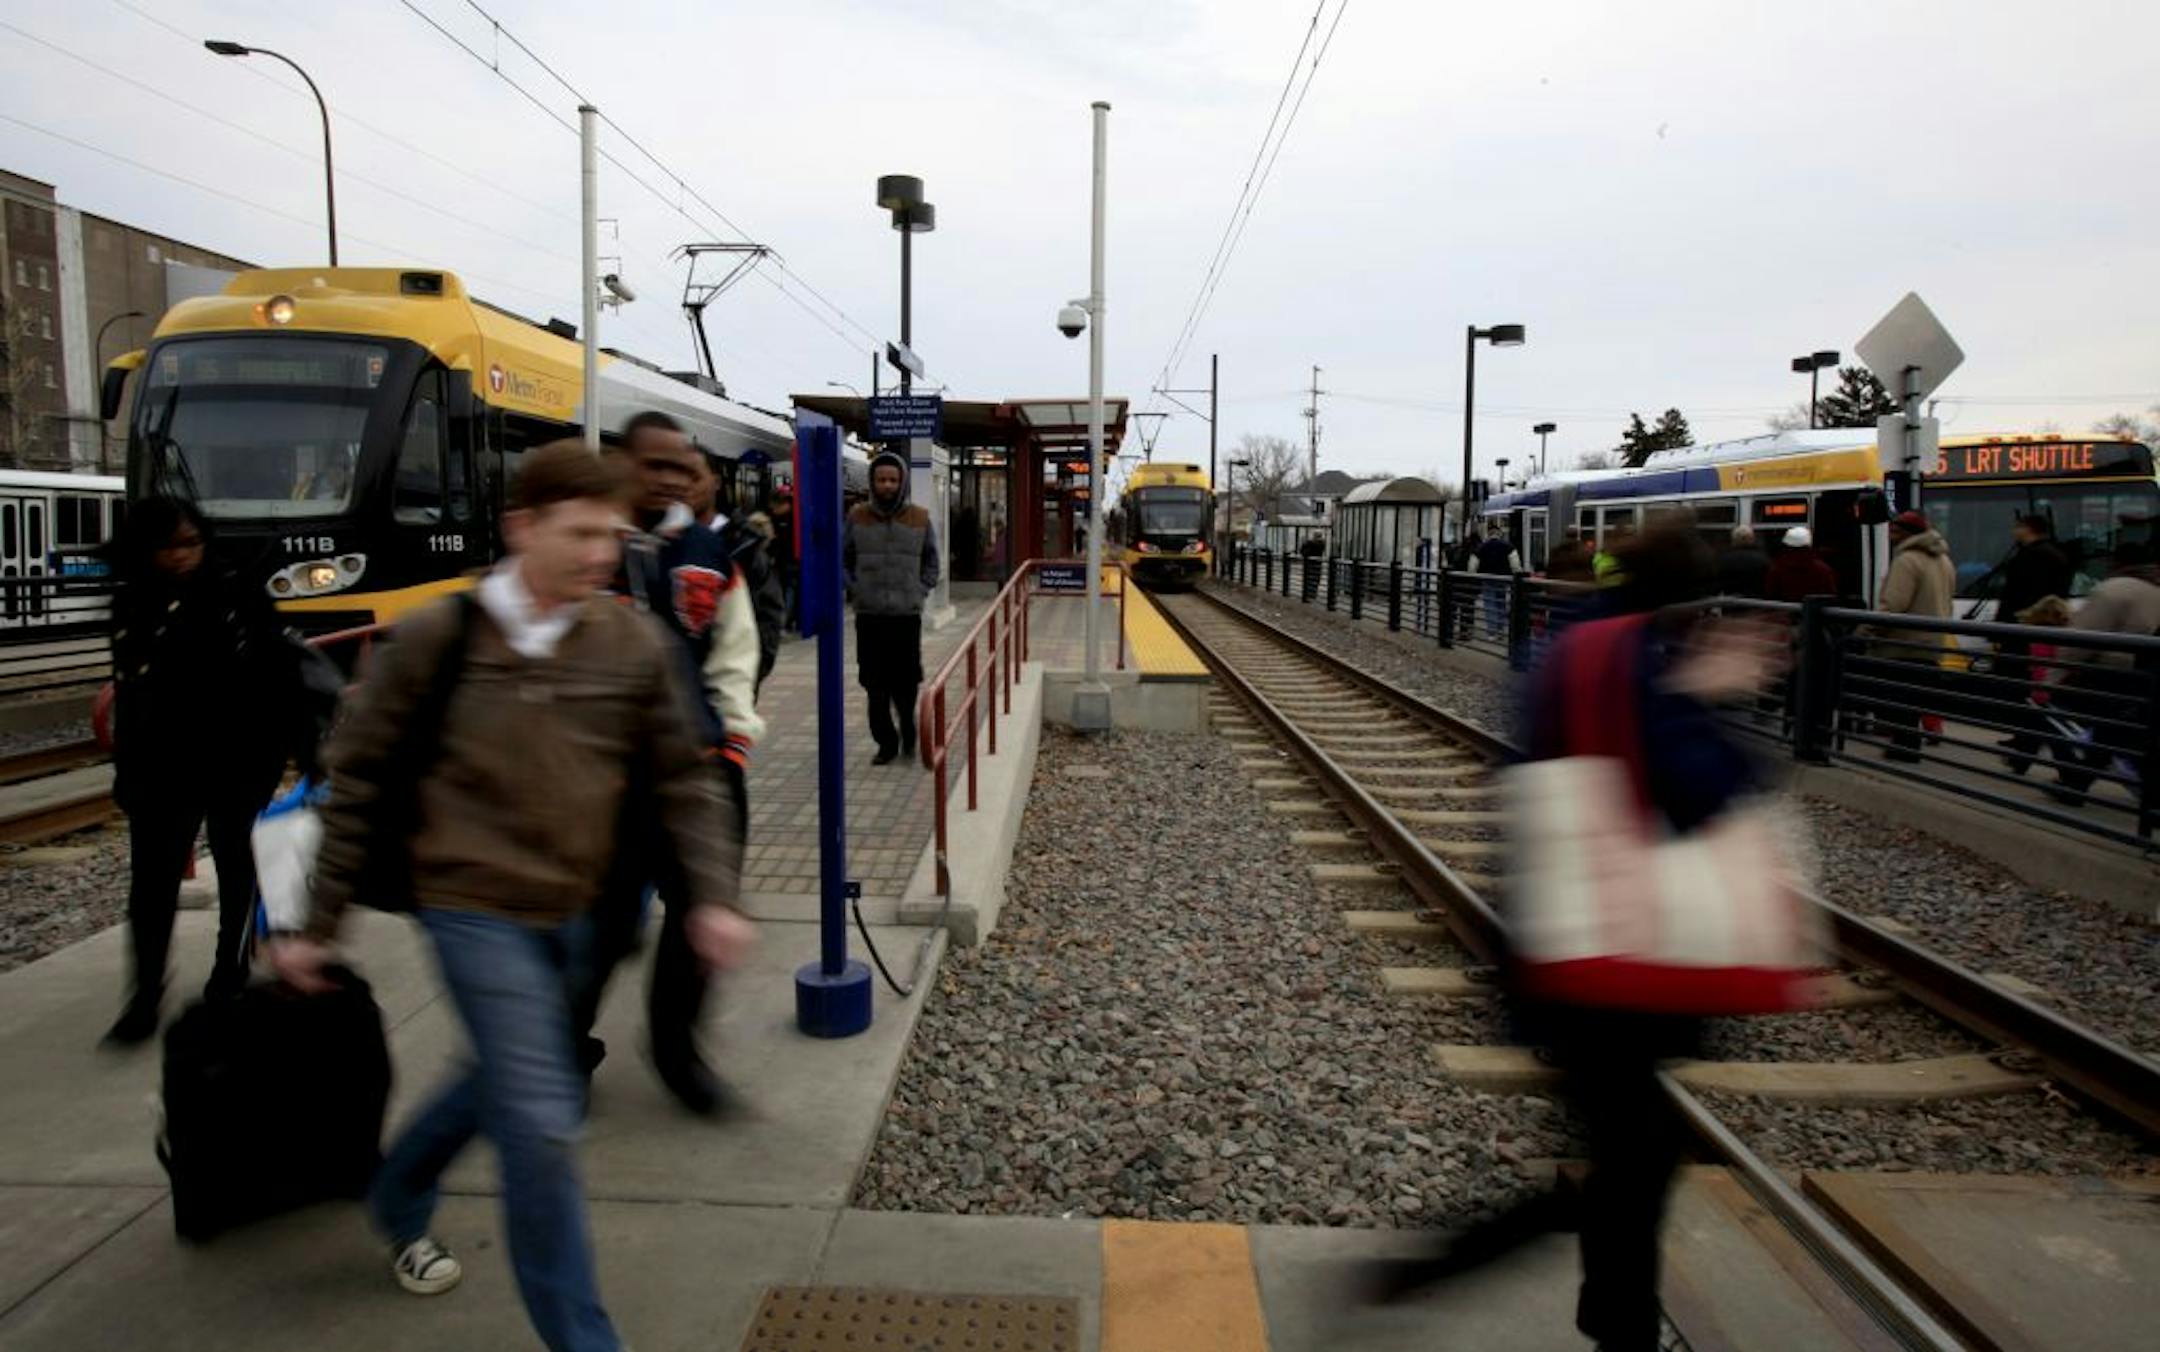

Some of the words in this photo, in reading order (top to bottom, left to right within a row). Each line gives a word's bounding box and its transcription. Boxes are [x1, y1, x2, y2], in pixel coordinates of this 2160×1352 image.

[1966, 446, 2002, 474] LRT
[2008, 443, 2095, 472] SHUTTLE
[282, 536, 335, 553] 111B
[428, 534, 464, 552] 111B
